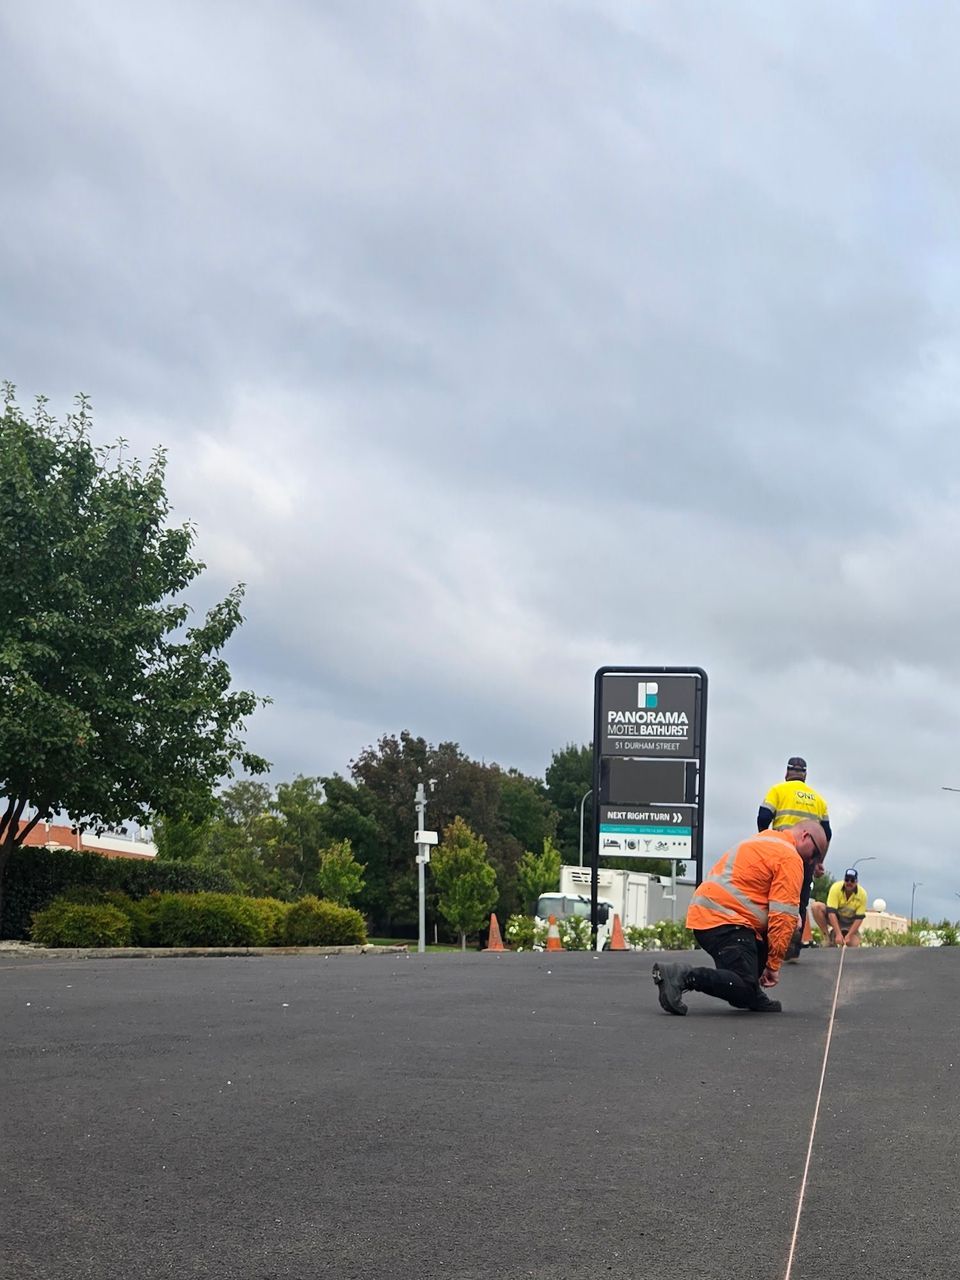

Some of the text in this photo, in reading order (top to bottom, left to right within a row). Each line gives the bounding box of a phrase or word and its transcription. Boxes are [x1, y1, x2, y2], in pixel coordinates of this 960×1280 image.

[607, 711, 688, 724] PANORAMA
[607, 724, 688, 736] MOTEL BATHURST
[615, 742, 680, 751] 51 DURHAM STREET
[607, 811, 670, 821] NEXT RIGHT TURN
